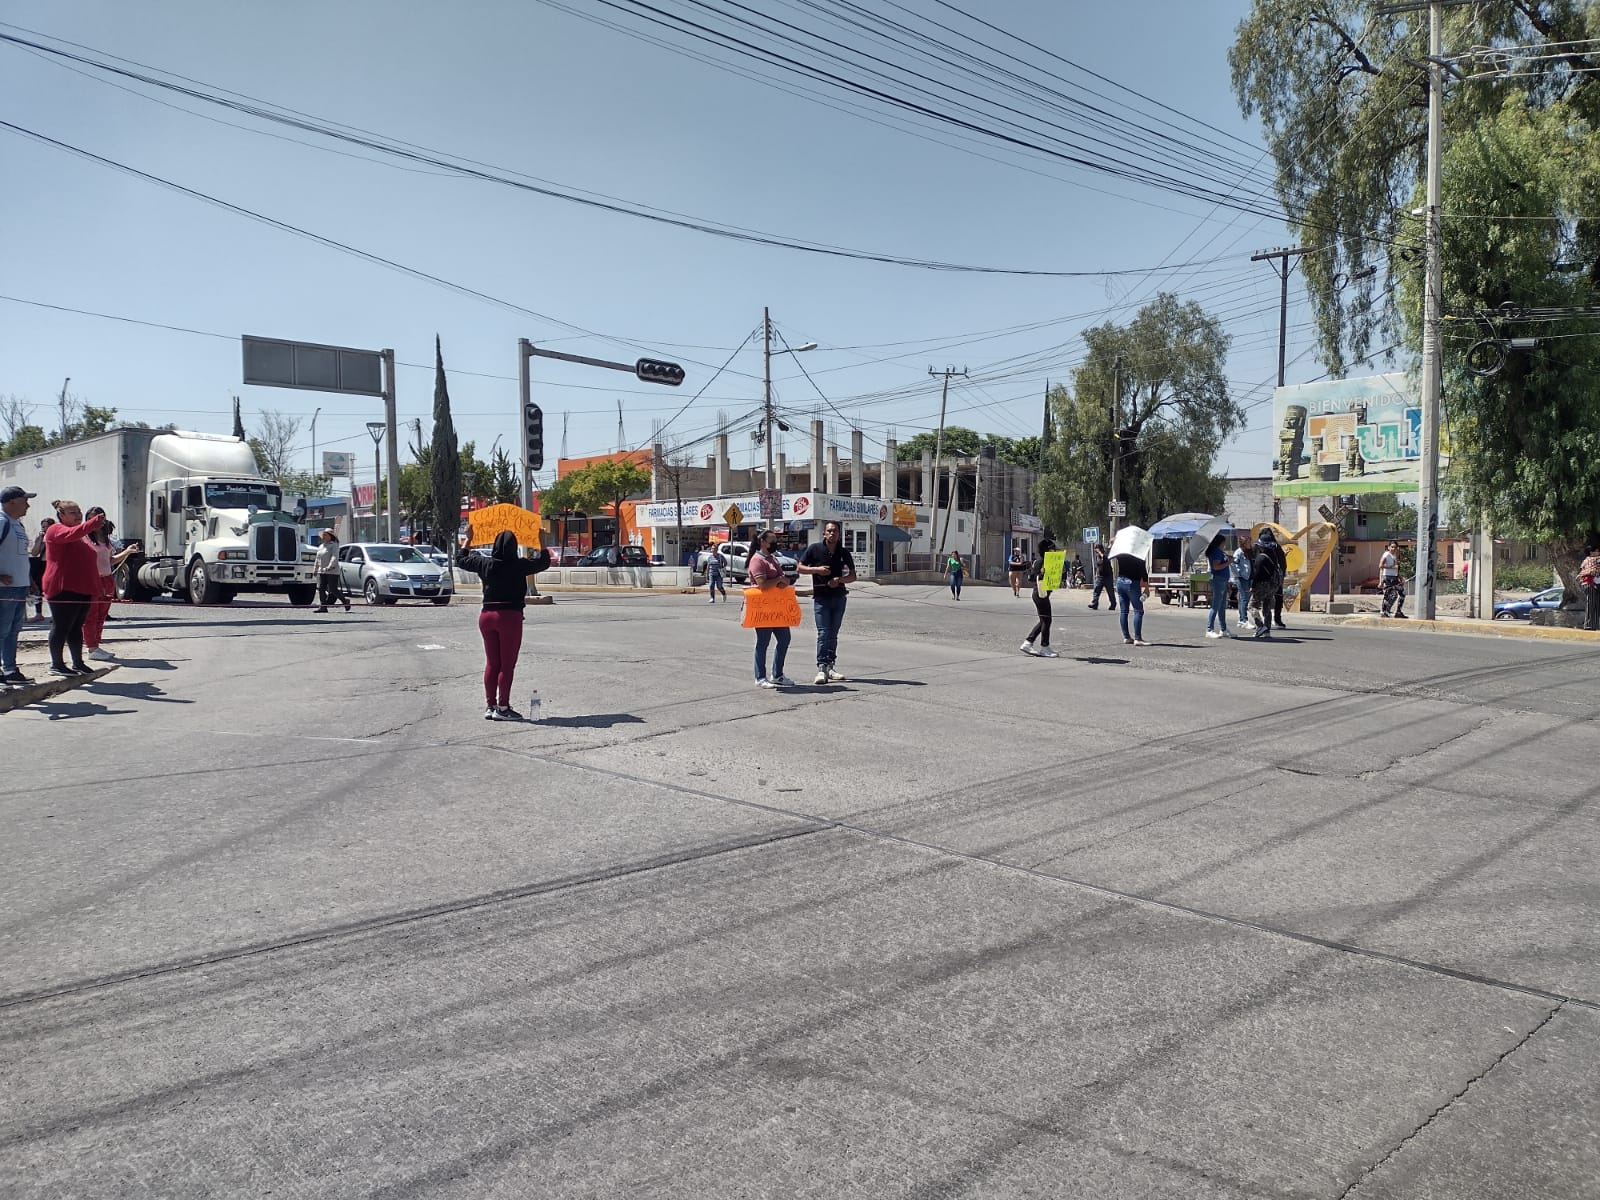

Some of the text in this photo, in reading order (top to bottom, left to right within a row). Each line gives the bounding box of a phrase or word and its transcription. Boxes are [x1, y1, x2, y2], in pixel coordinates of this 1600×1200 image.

[1309, 392, 1416, 414] BIENVENIDOS
[649, 506, 673, 517] FARMACIAS
[829, 499, 855, 512] FARMACIAS
[856, 502, 879, 514] SIMILARES
